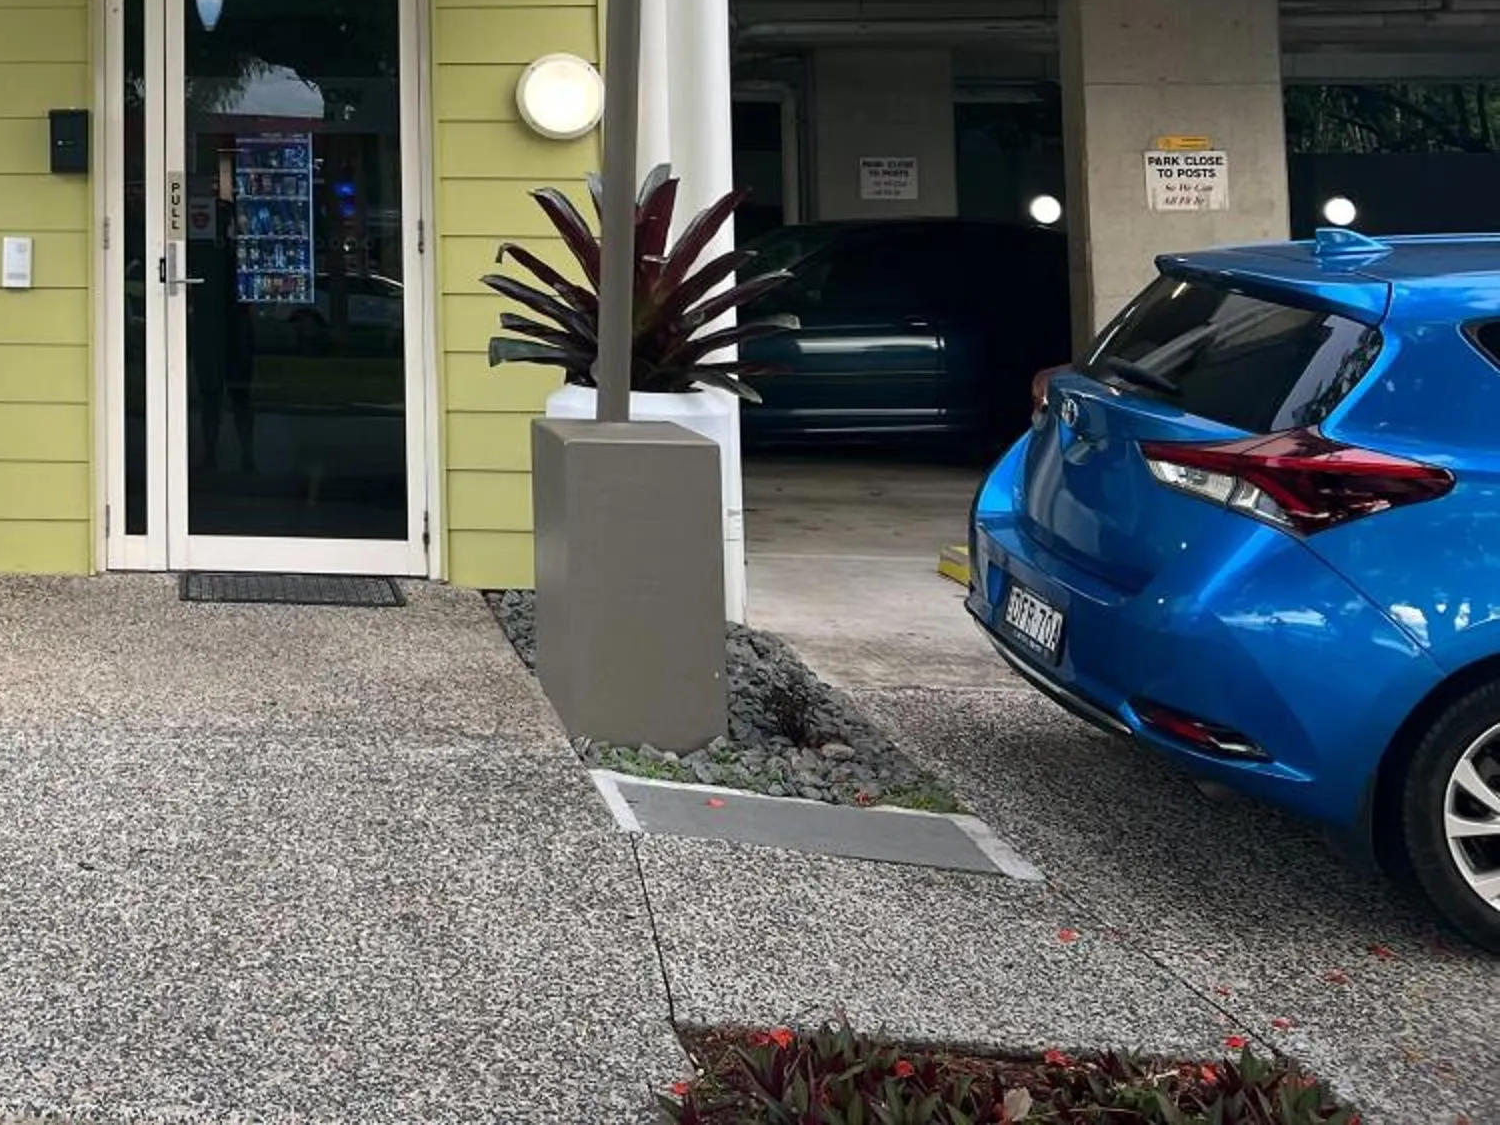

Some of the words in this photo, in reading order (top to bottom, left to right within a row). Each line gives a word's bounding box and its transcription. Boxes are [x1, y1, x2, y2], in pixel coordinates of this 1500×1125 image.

[1147, 156, 1180, 166] PARK
[1184, 156, 1224, 166] CLOSE
[1156, 168, 1173, 178] TO
[1177, 168, 1217, 178] POSTS
[171, 182, 181, 230] PULL
